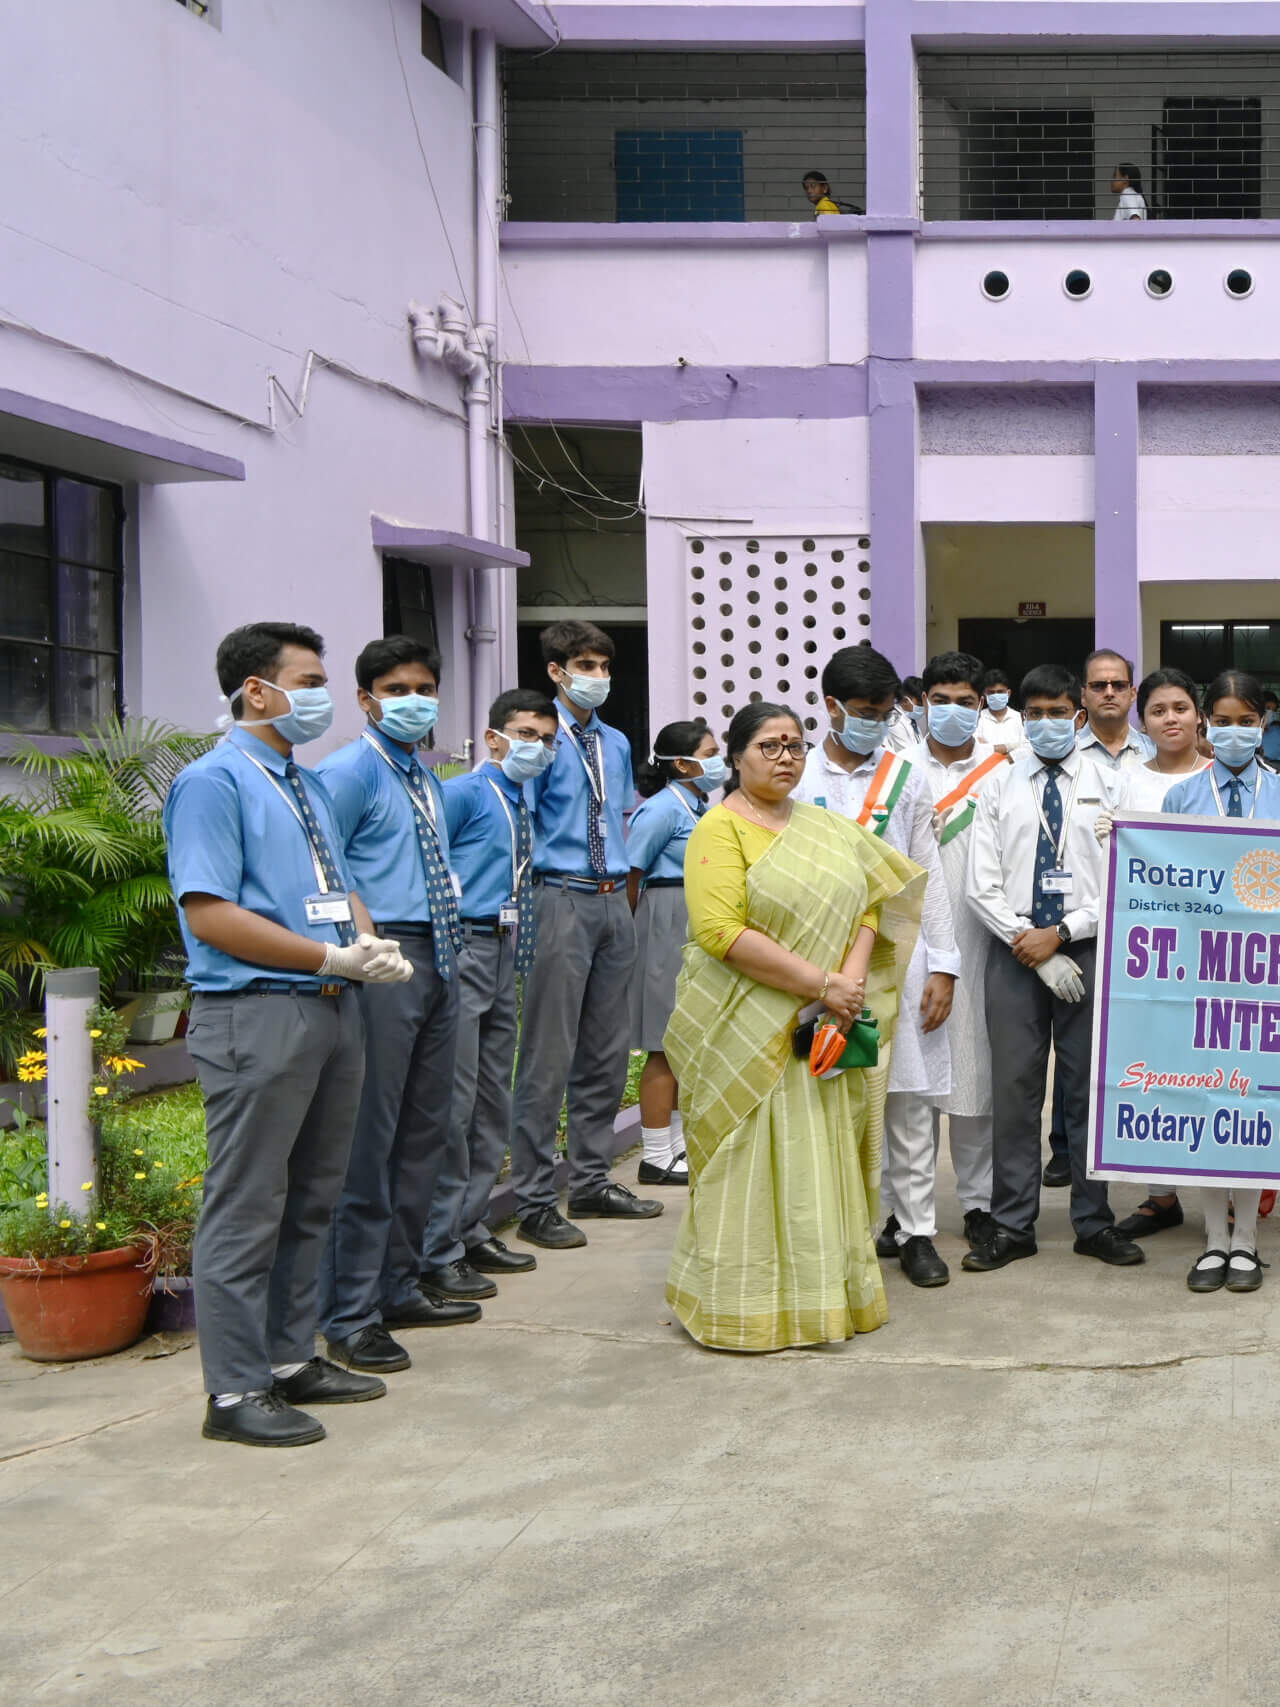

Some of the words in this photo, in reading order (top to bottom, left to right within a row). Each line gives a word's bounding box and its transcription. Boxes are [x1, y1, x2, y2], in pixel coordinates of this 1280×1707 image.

[1128, 857, 1225, 895] Rotary
[1128, 898, 1180, 913] District
[1184, 901, 1224, 916] 3240
[1126, 925, 1186, 982] ST.
[1118, 1061, 1225, 1094] Sponsored
[1228, 1068, 1251, 1097] by
[1116, 1103, 1206, 1152] Rotary
[1212, 1107, 1273, 1147] Club
